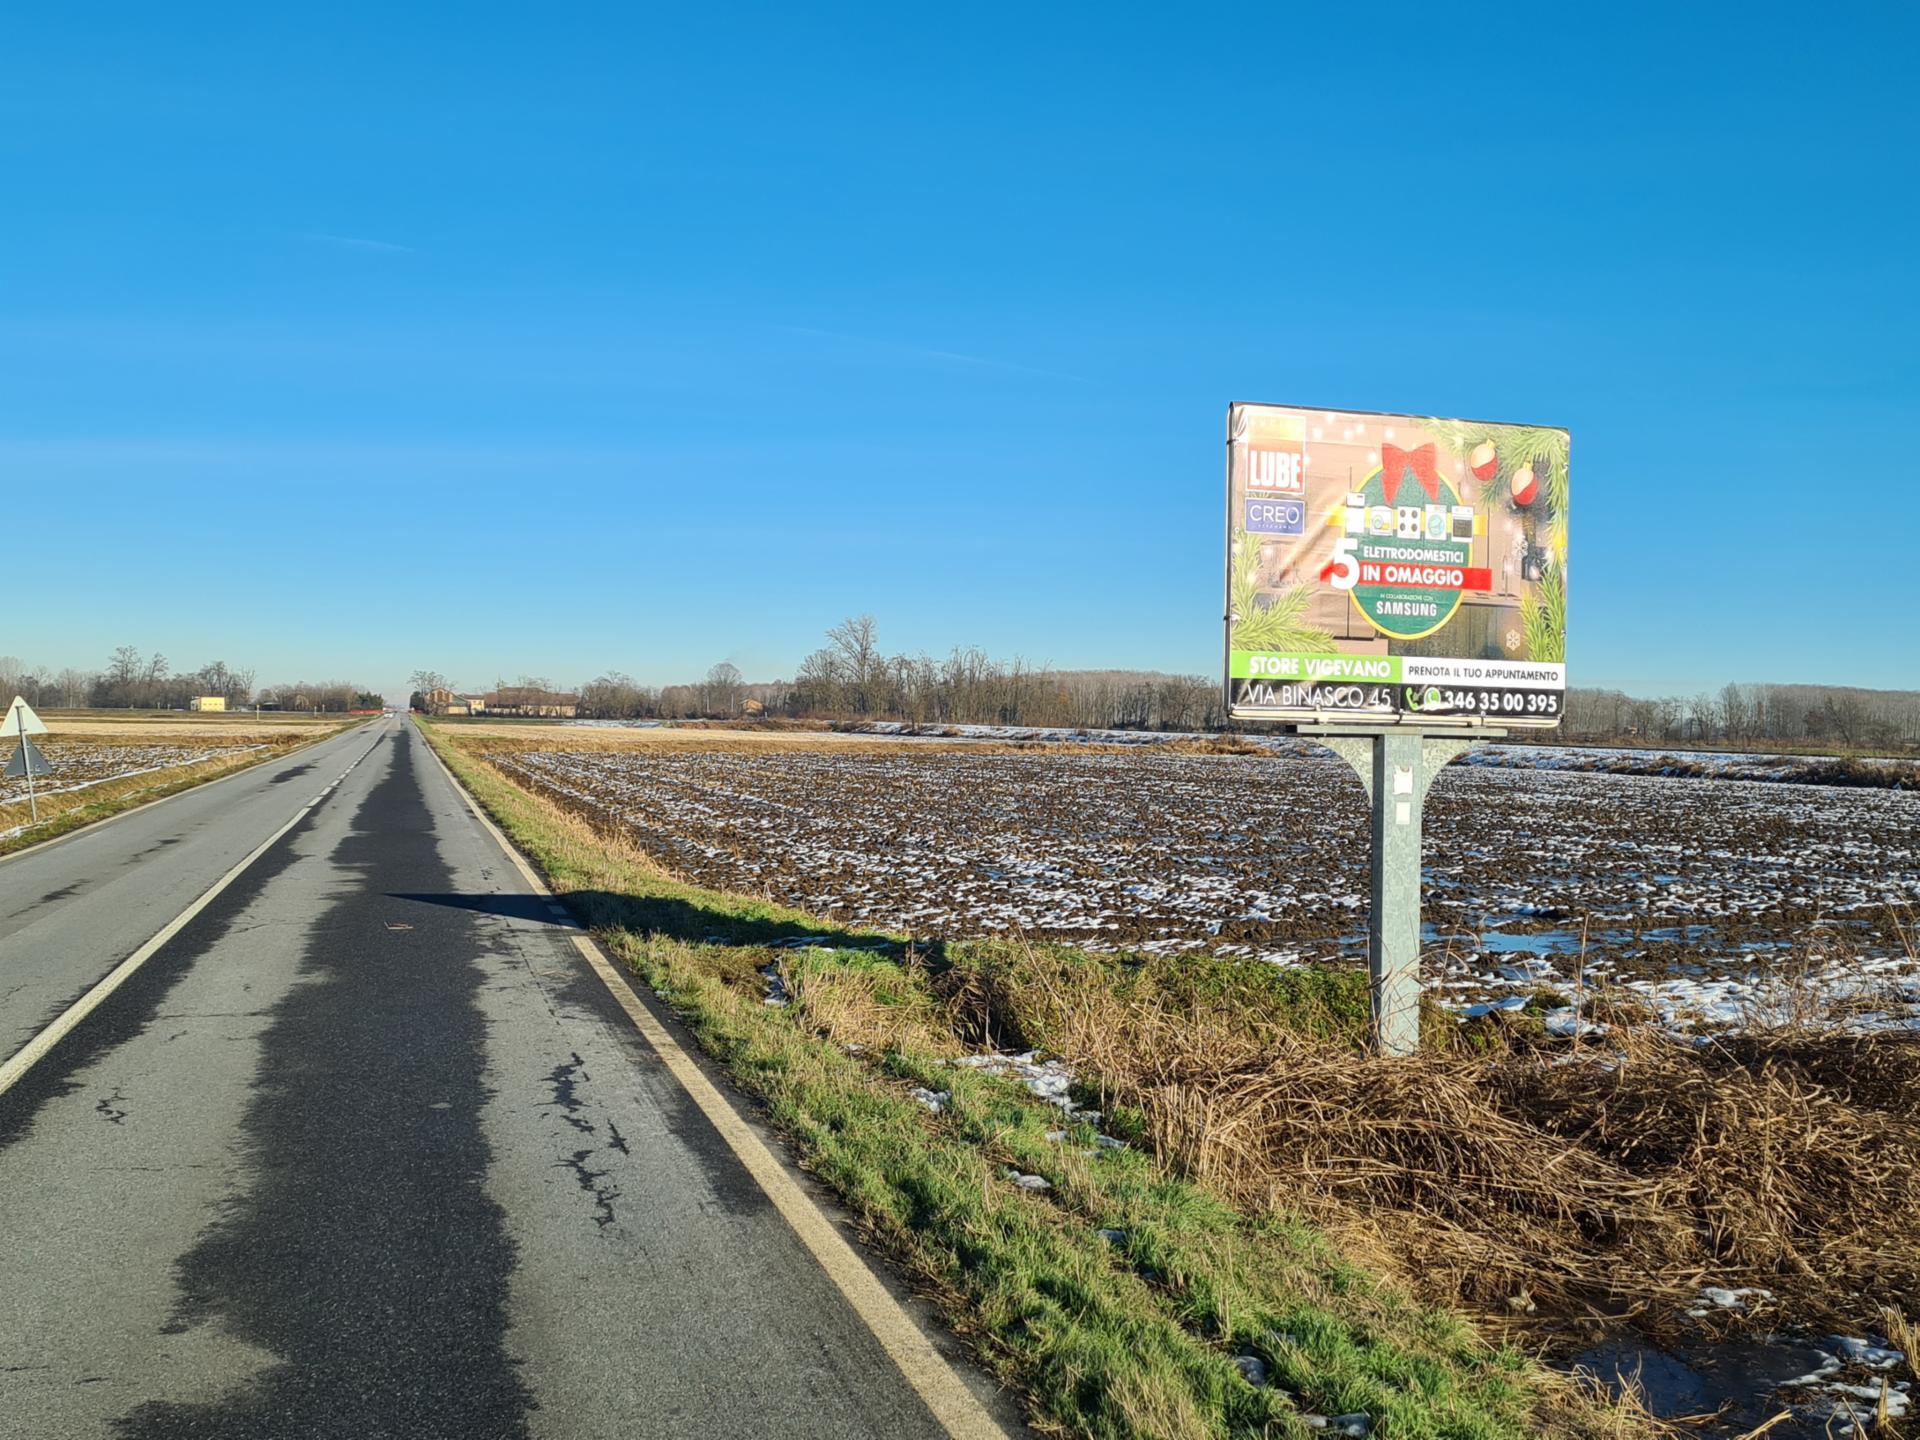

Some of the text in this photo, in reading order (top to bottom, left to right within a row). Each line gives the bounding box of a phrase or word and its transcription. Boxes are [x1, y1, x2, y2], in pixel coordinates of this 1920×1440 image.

[1250, 450, 1301, 489] LUBE
[1249, 504, 1300, 524] CREO
[1330, 538, 1360, 590] 5
[1363, 546, 1464, 563] ELETTRODOMESTICI
[1363, 565, 1464, 586] IN OMAGGIO
[1376, 600, 1437, 617] SAMSUNG
[1250, 656, 1391, 678] STORE VIGEVANO
[1408, 665, 1559, 681] PRENOTA IL TUO APPUNTAMENTO
[1248, 684, 1391, 707] VIA BINASCO 45
[1445, 691, 1557, 712] 346 35 00 395
